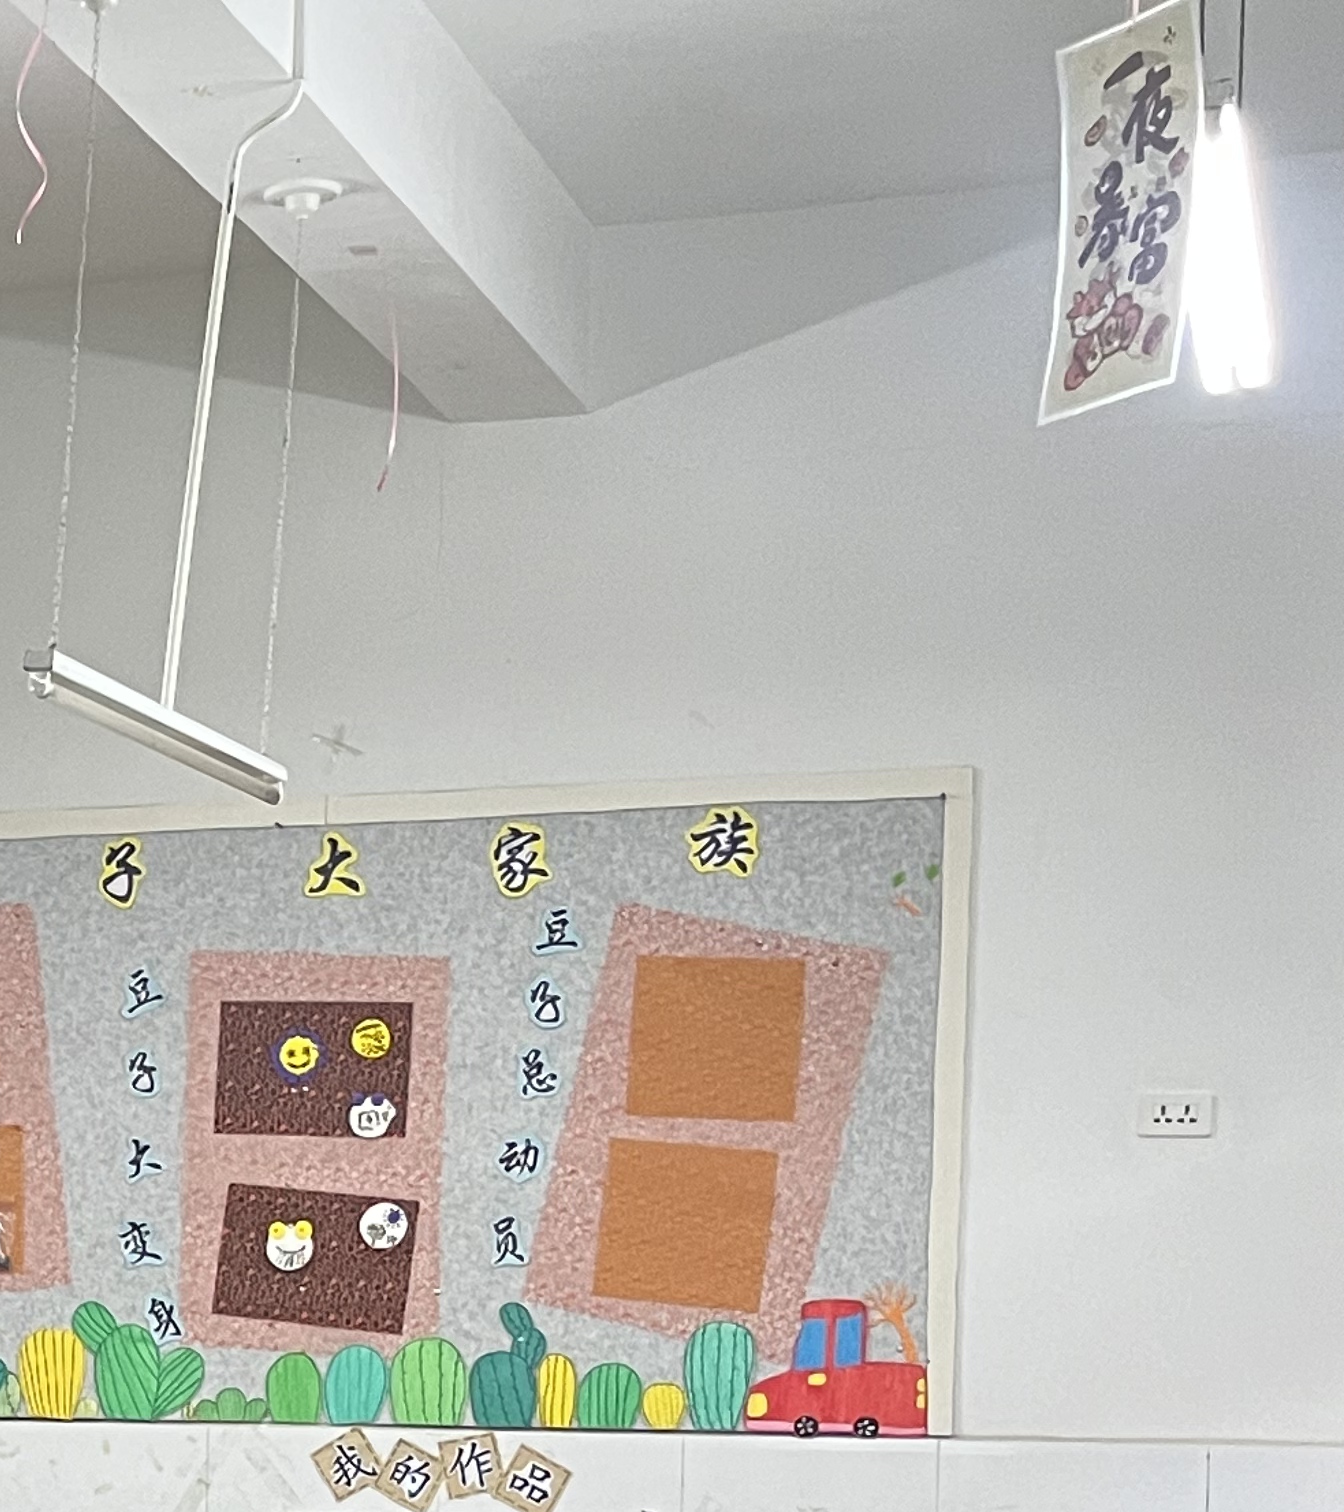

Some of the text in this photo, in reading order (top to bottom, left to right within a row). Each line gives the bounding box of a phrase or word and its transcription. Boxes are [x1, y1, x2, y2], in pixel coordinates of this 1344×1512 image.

[122, 972, 185, 1338] 豆子大变身
[493, 909, 577, 1266] 豆子总动员
[332, 1445, 550, 1504] 我的作品
